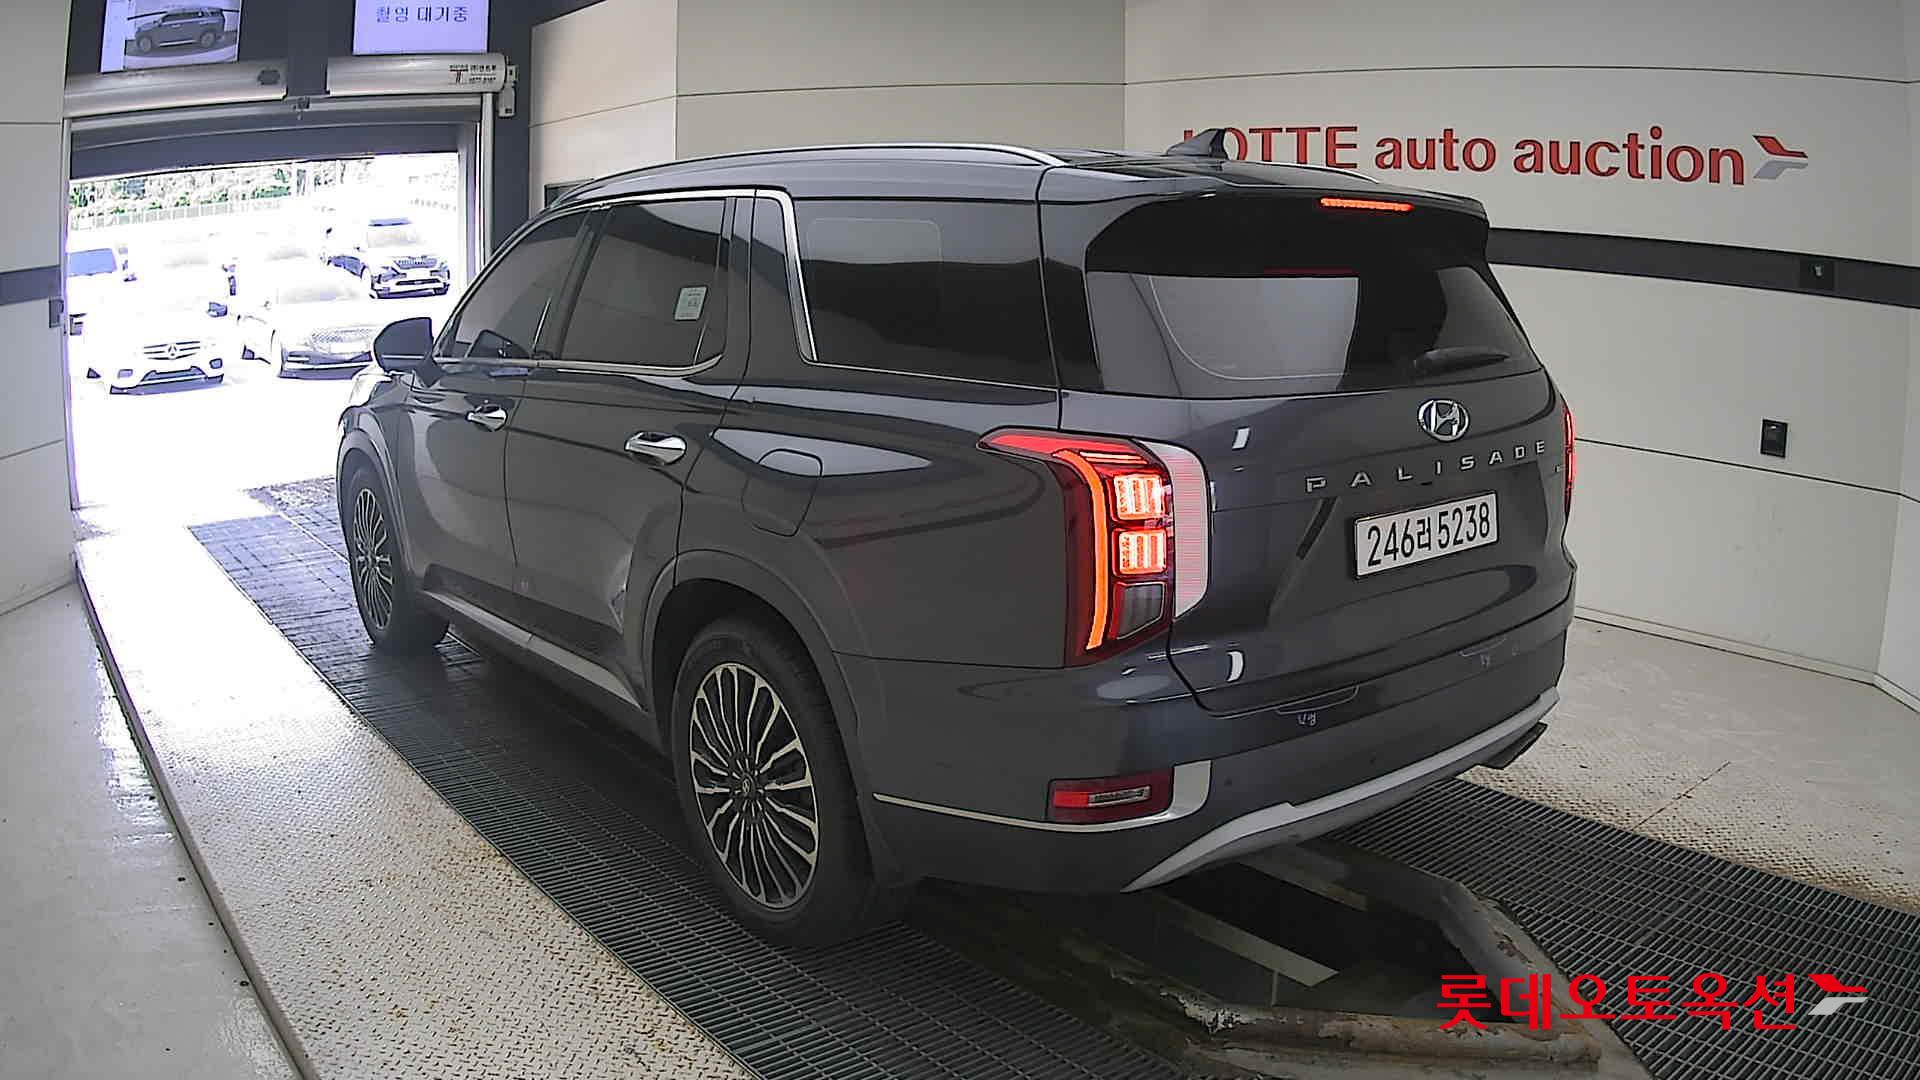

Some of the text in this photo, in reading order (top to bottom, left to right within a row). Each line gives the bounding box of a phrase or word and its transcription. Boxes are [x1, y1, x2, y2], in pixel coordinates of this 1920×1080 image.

[417, 5, 470, 23] 대기중
[1184, 125, 1745, 185] OTTE auto auction
[1305, 439, 1546, 492] PALISADE
[1367, 501, 1491, 567] 246러 5238
